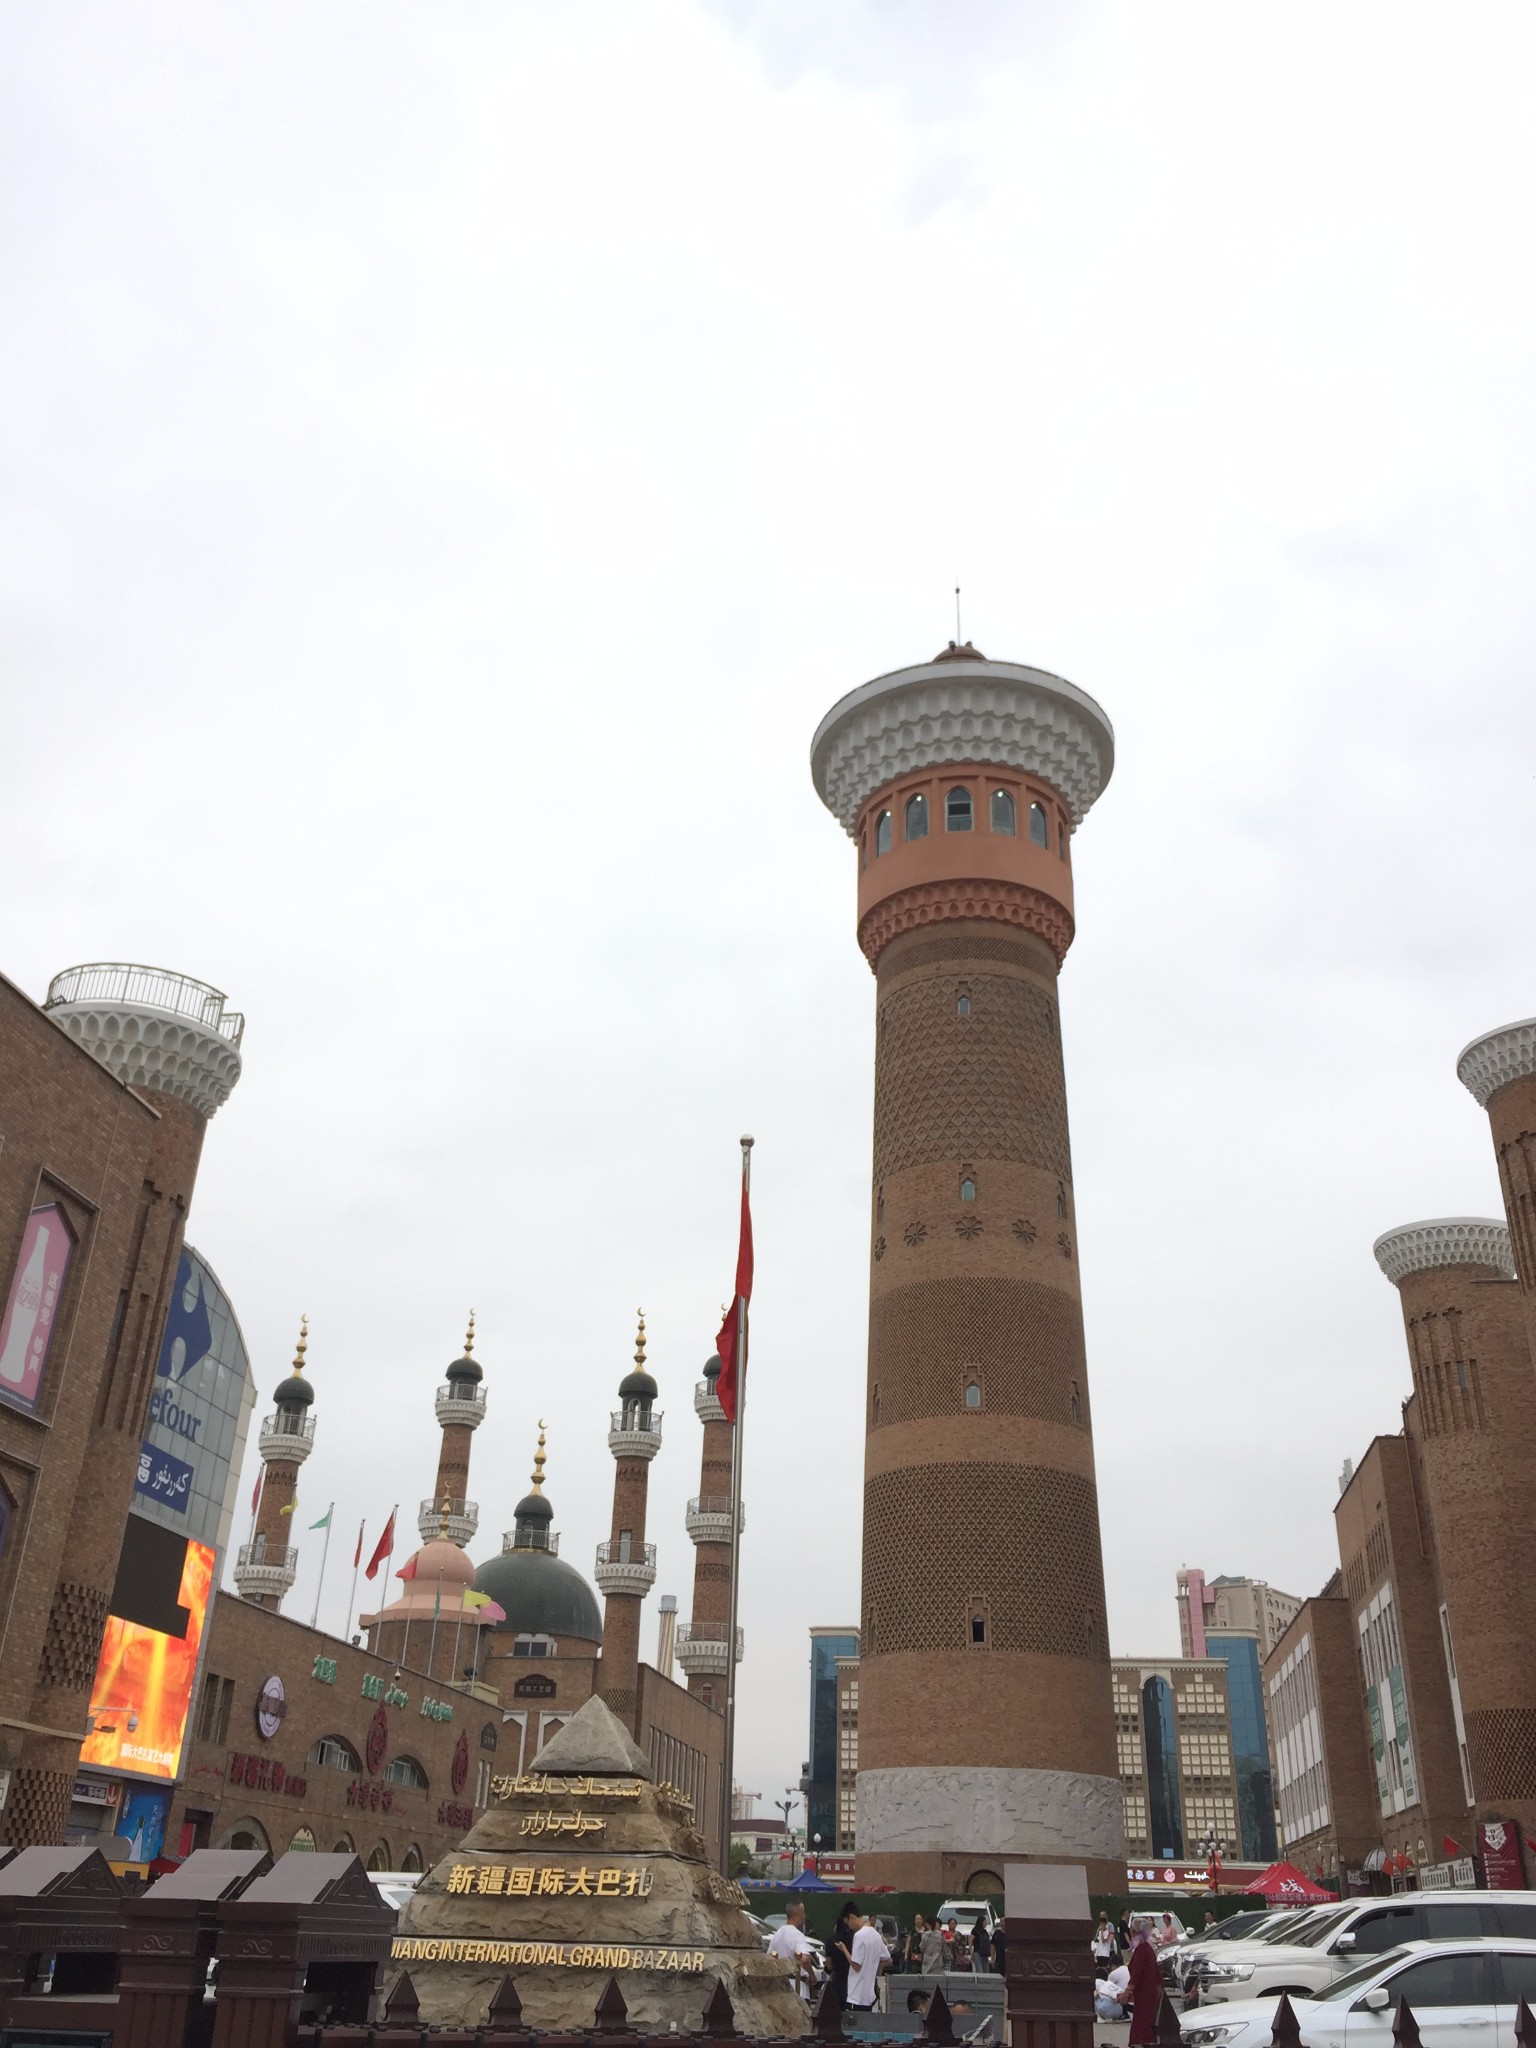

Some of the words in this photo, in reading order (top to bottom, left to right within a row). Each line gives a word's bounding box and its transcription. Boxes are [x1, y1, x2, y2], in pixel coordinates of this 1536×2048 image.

[446, 1864, 653, 1897] 新疆国际大巴扎
[438, 1940, 567, 1965] INTERNATIONAL
[570, 1945, 631, 1969] GRAND
[632, 1950, 705, 1972] BAZAAR
